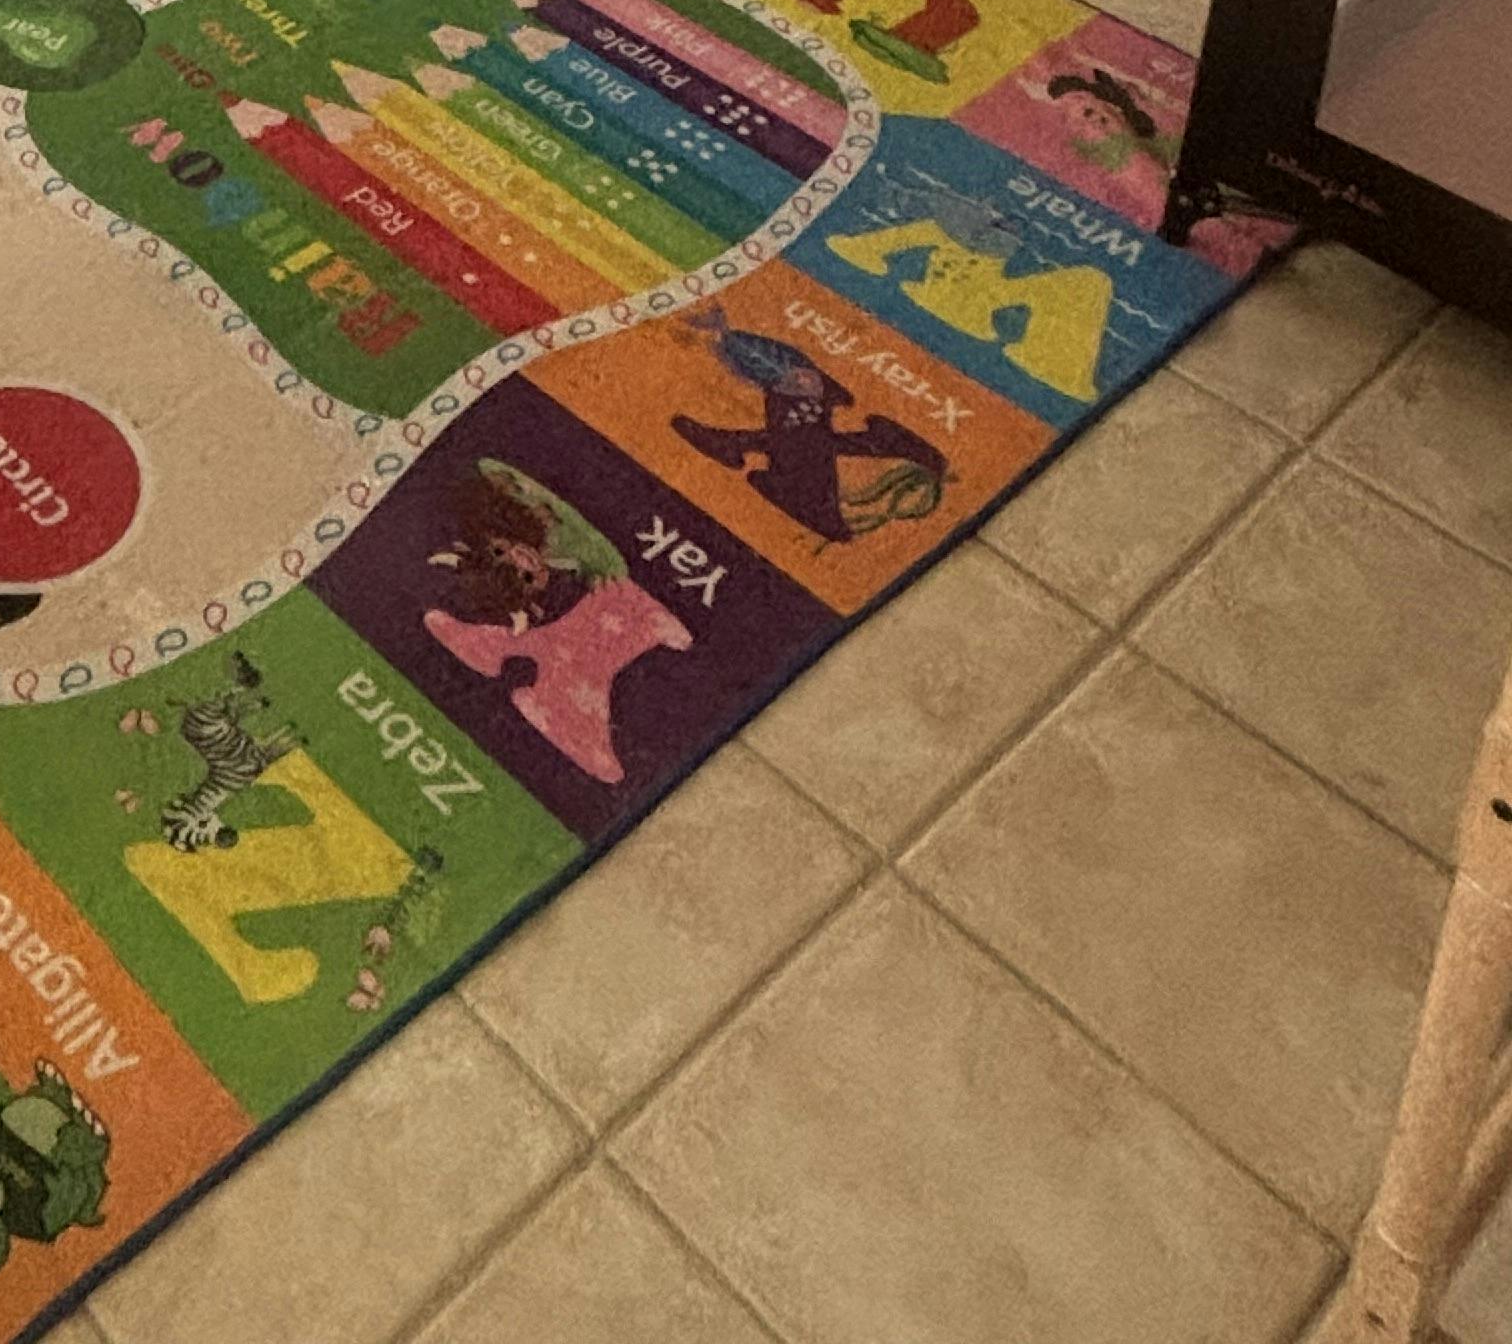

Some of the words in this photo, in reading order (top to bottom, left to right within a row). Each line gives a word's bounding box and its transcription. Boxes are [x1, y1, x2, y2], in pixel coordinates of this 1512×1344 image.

[1, 17, 68, 52] Pear
[155, 42, 217, 90] One
[199, 19, 260, 67] Two
[593, 26, 692, 91] Purple
[522, 76, 595, 130] Cyan
[569, 58, 638, 104] Blue
[473, 98, 564, 162] Green
[343, 184, 416, 236] Red
[373, 141, 481, 221] Orange
[126, 117, 423, 357] Rainbow
[1006, 175, 1146, 266] Whale
[784, 300, 859, 356] fish
[856, 351, 976, 433] X-ray
[635, 515, 729, 608] Yak
[336, 670, 485, 816] Zebra
